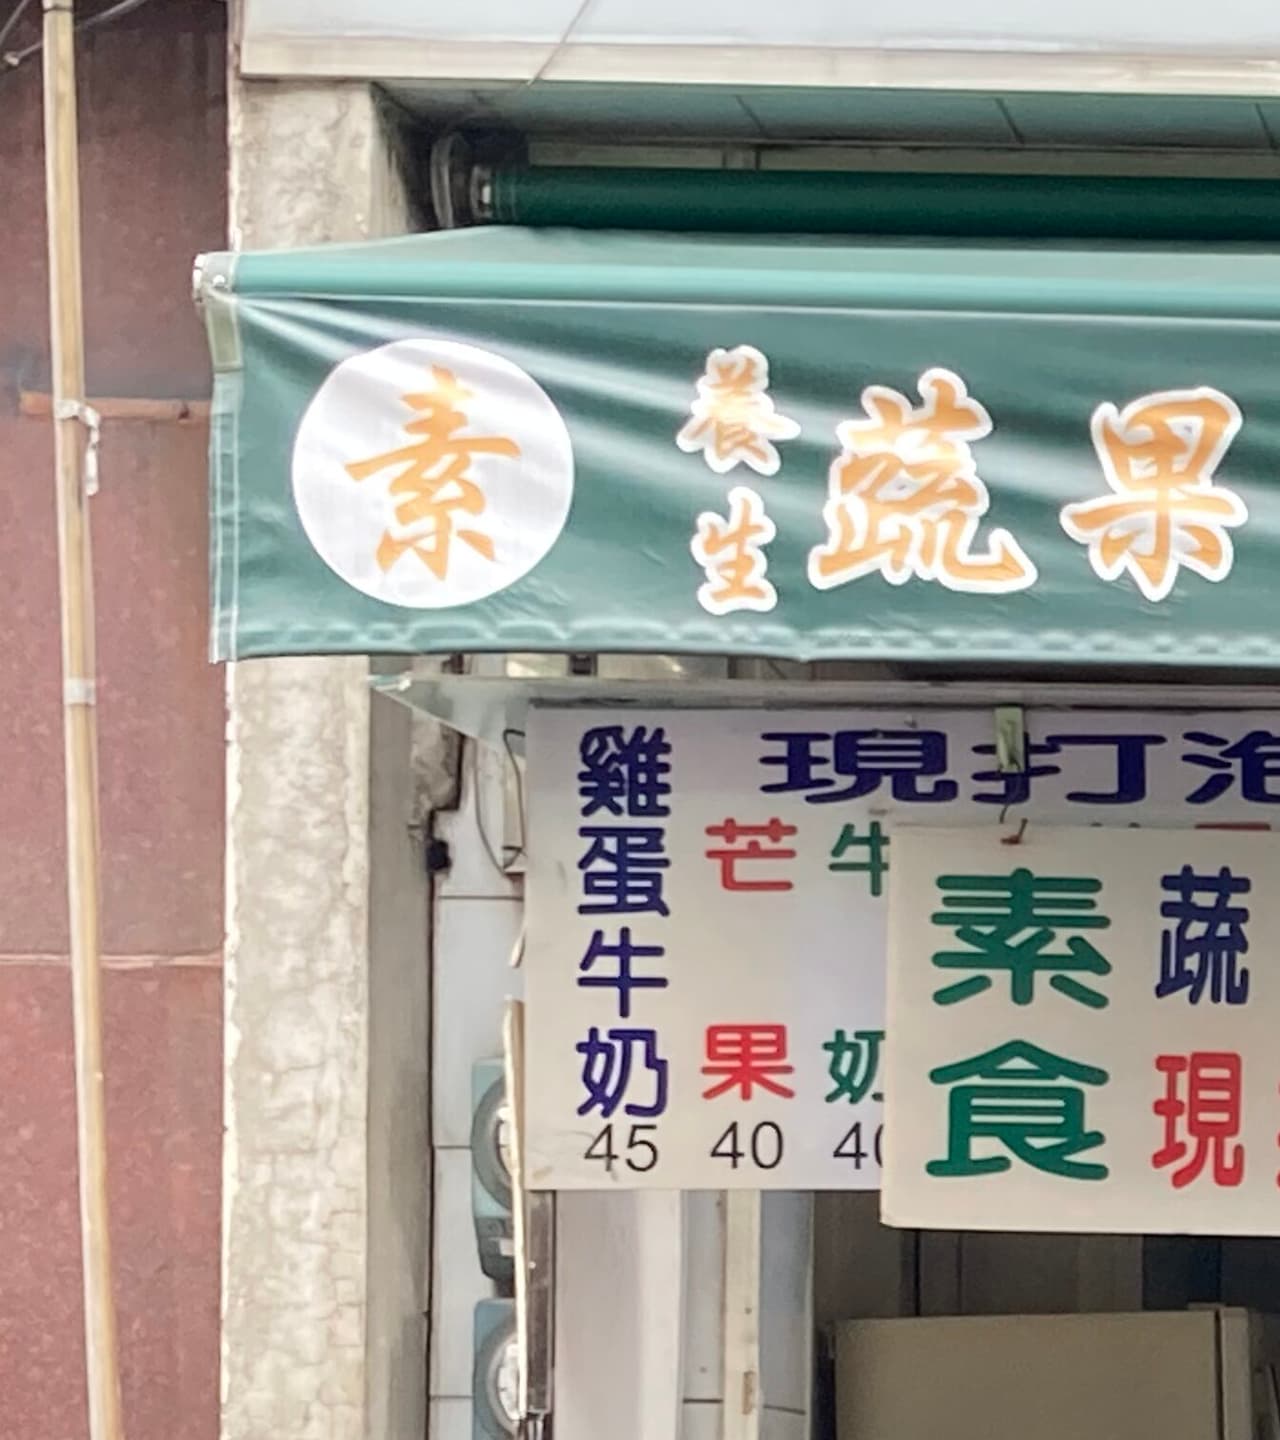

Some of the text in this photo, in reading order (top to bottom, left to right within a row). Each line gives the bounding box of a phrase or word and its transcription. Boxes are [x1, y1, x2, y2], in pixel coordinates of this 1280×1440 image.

[344, 364, 522, 581] 素
[692, 354, 786, 606] 養生
[814, 372, 1240, 592] 蔬果
[577, 725, 670, 1118] 雞蛋牛奶
[702, 818, 796, 1101] 芒果
[926, 866, 1110, 1181] 素食
[584, 1123, 659, 1172] 45
[710, 1120, 784, 1170] 40
